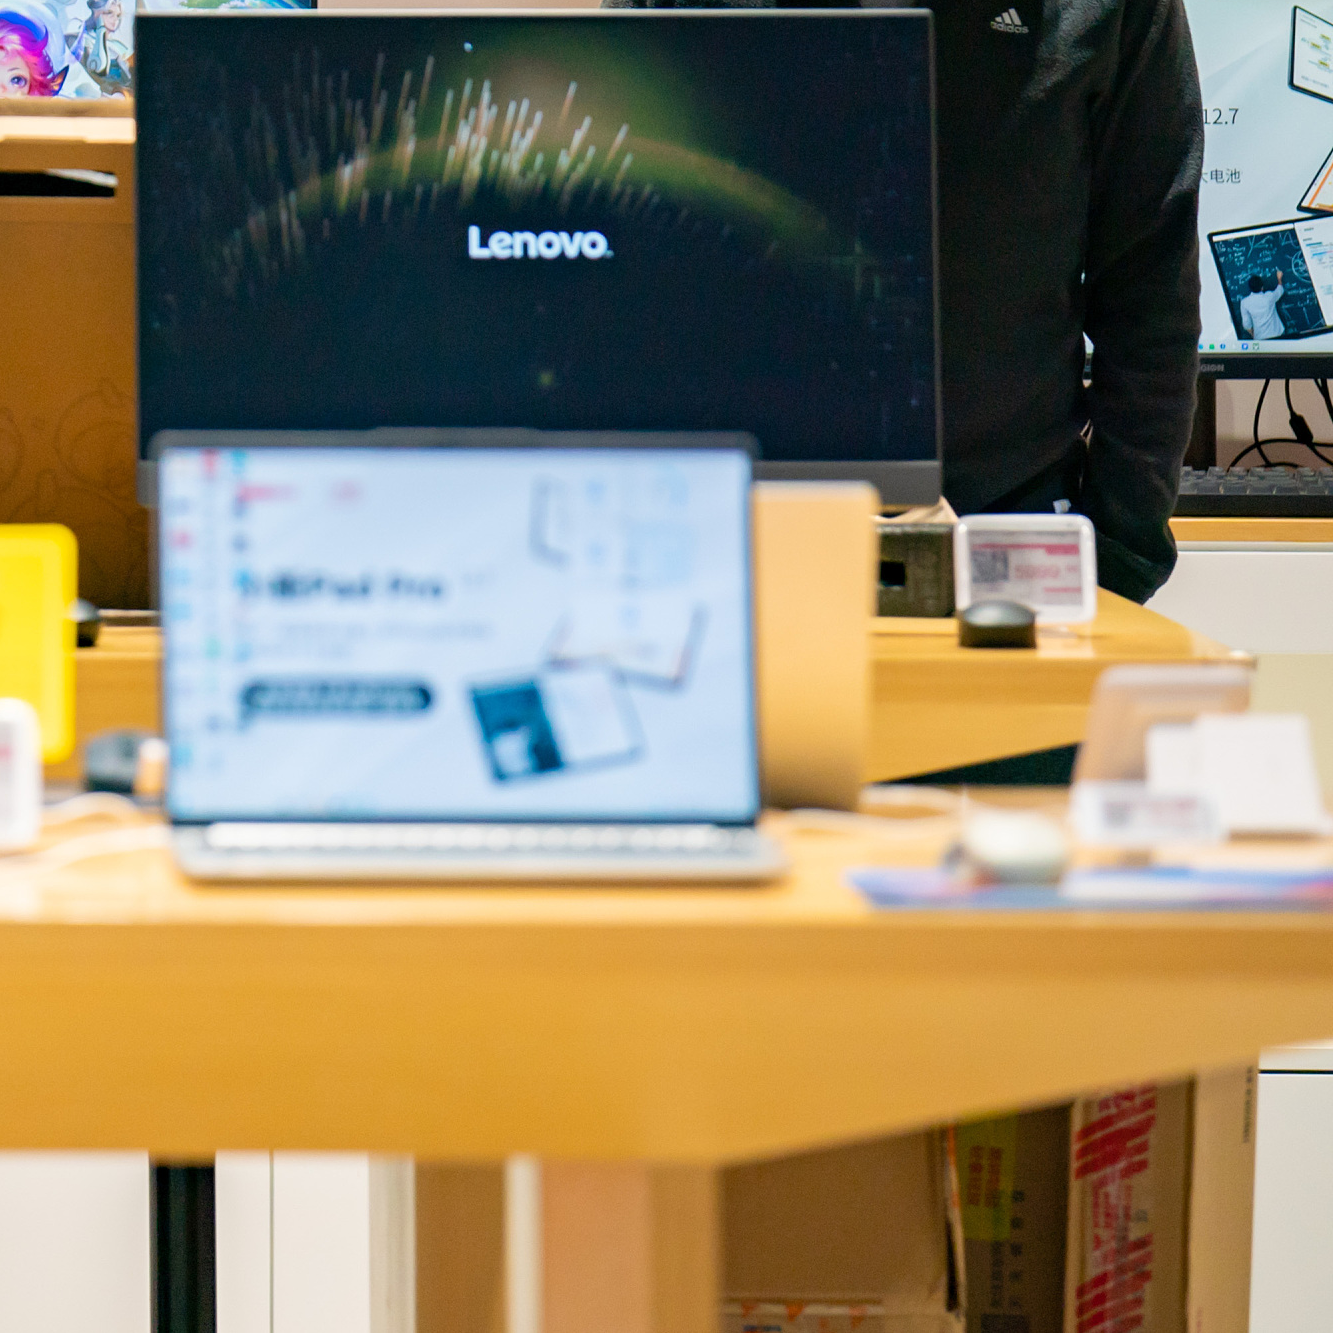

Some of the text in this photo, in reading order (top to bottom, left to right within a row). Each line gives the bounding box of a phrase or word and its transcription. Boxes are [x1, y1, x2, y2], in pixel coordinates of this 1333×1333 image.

[990, 21, 1029, 34] adidas
[1204, 107, 1239, 125] 12.7
[468, 224, 608, 260] Lenovo
